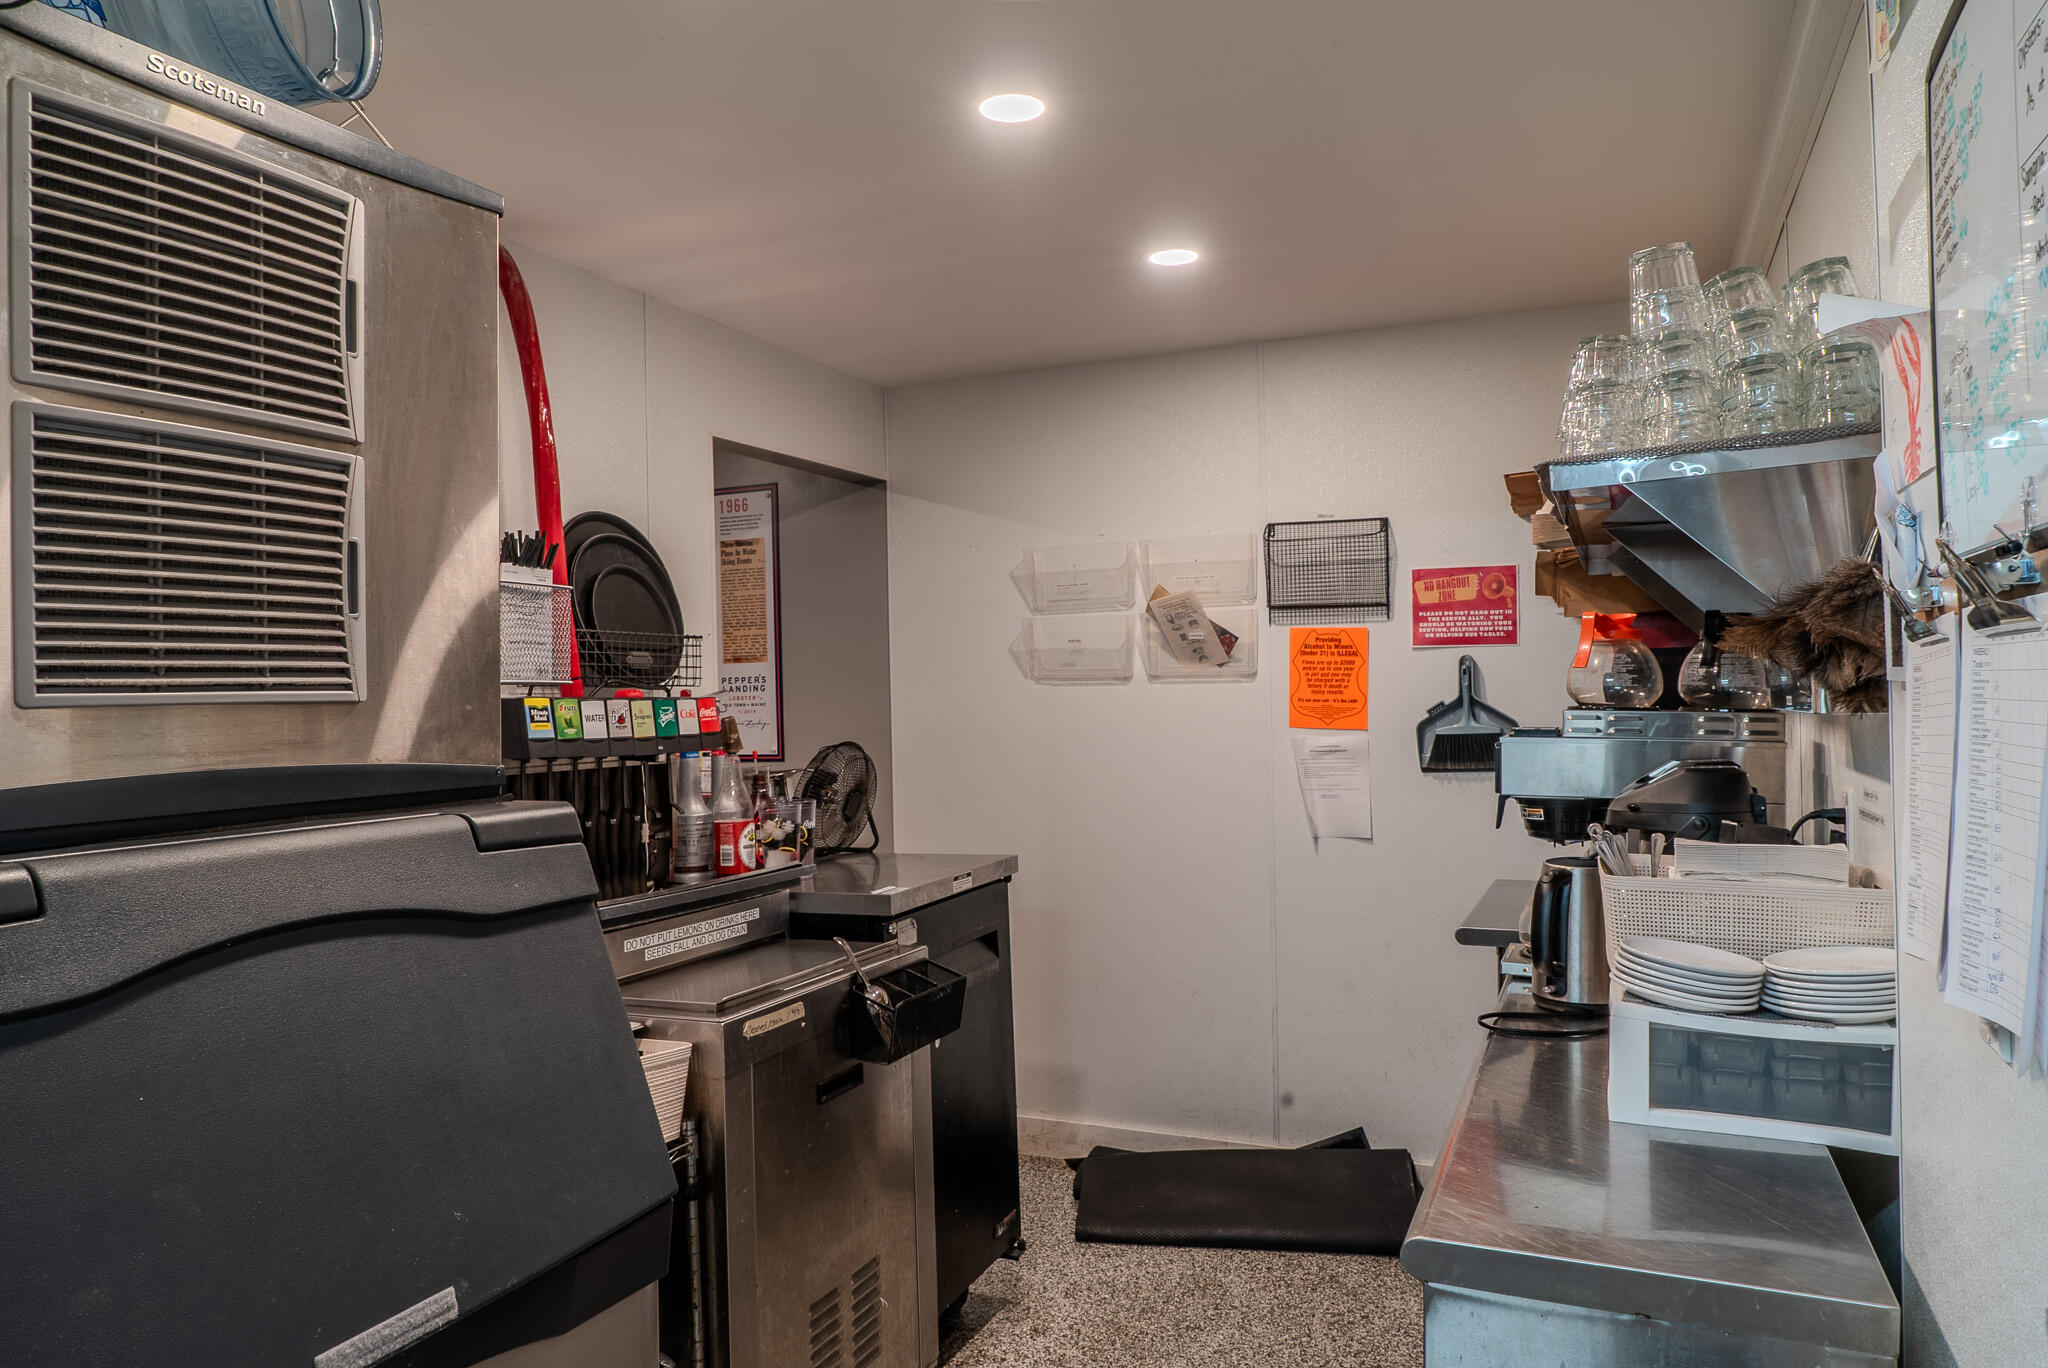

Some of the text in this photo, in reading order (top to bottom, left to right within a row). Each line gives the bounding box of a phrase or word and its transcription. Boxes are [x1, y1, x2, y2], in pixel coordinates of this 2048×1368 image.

[147, 53, 266, 116] Scotsman
[719, 497, 748, 513] 1966
[1424, 576, 1470, 592] NO HANGOUT
[1438, 590, 1456, 602] ZONE
[721, 674, 767, 685] PEPPER'S
[584, 714, 605, 722] WATER
[680, 709, 696, 719] Coke
[625, 940, 638, 951] DO
[640, 935, 655, 947] NOT
[657, 930, 672, 943] PUT
[673, 923, 703, 939] LEMONS
[704, 920, 714, 931] ON
[716, 914, 739, 928] DRINKS
[646, 924, 746, 959] SEEDS FALL AND CLOG DRAIN
